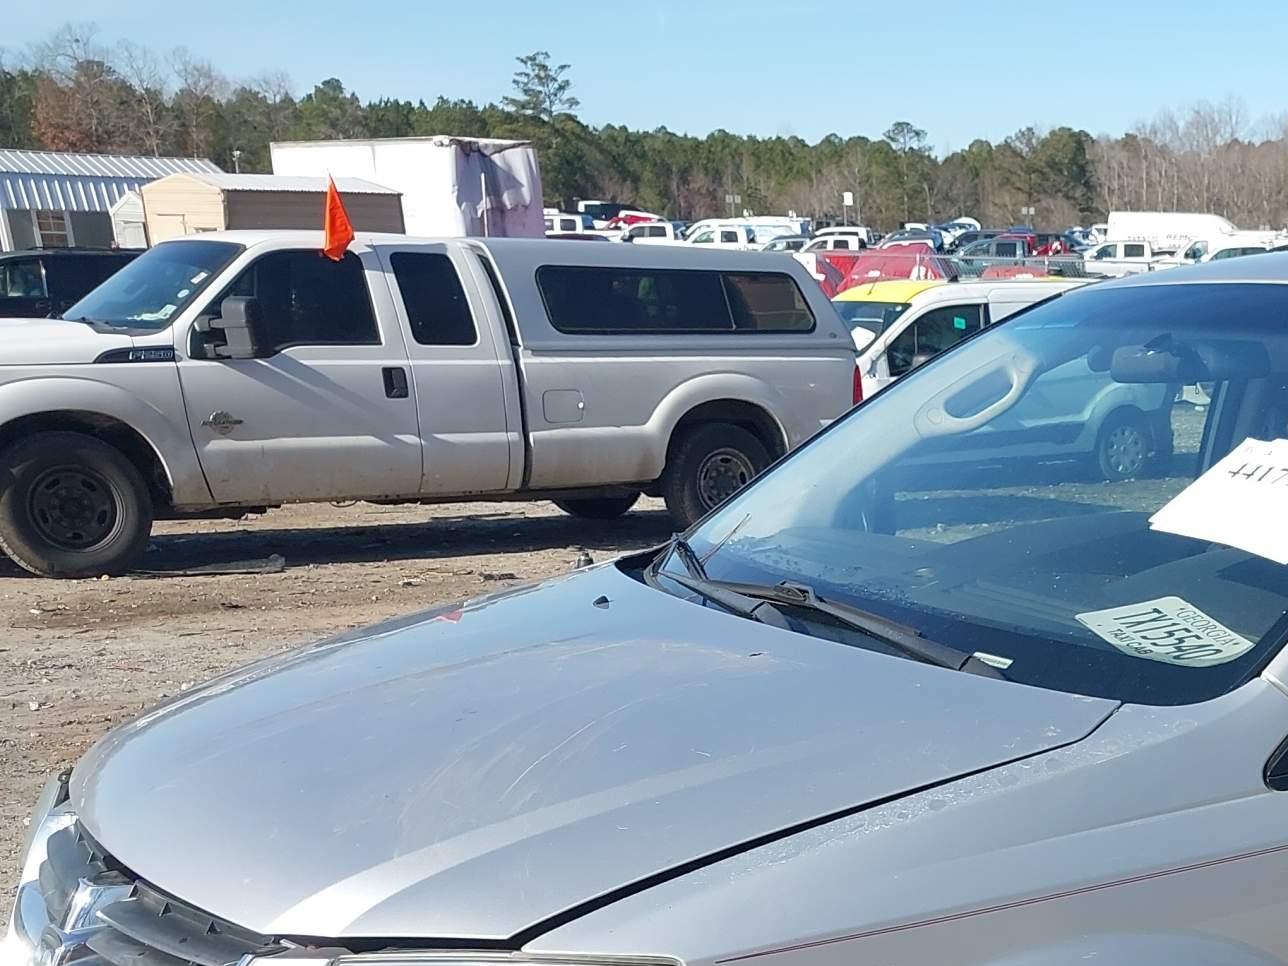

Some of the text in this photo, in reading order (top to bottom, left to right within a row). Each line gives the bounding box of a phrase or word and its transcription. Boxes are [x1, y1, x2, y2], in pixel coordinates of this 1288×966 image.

[1108, 628, 1153, 655] TAXI CAB
[1113, 607, 1223, 661] TX15540
[1176, 609, 1236, 646] GEORGIA
